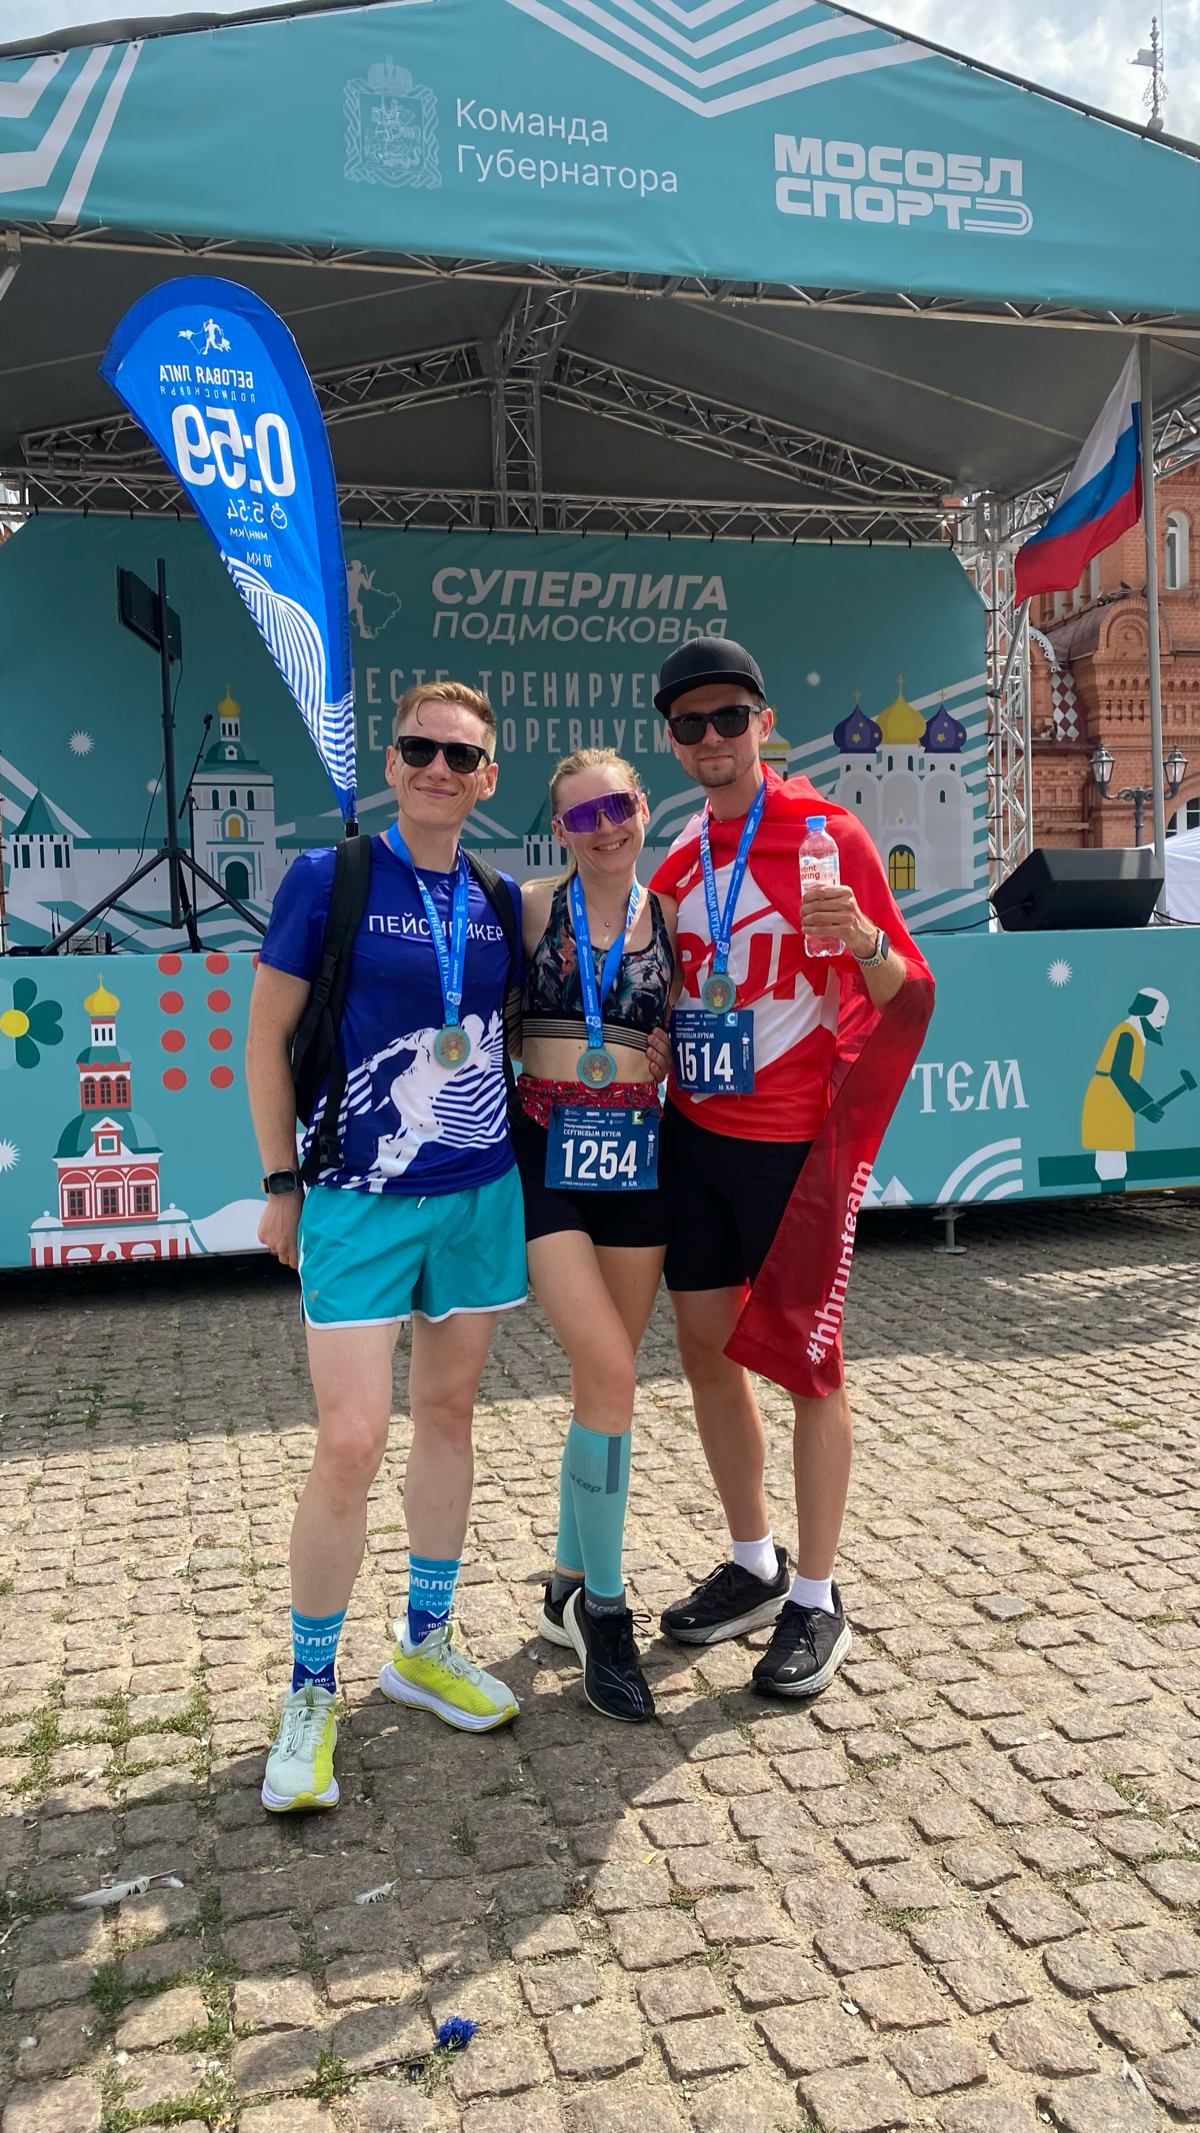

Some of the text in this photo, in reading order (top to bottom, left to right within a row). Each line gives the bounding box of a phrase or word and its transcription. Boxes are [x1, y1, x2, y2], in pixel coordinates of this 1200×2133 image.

[456, 97, 609, 144] Команда
[456, 143, 679, 197] Губернатора
[774, 133, 1024, 197] МОСОБЛ
[775, 178, 1033, 236] СПОРТ
[431, 566, 729, 612] СУПЕРЛИГА
[432, 610, 728, 647] ПОДМОСКОВЬЯ
[502, 717, 671, 754] ОРЕВНУЕМ
[800, 872, 820, 882] pring
[368, 912, 503, 941] ПЕЙСЙКЕР
[677, 1042, 734, 1082] 1514
[911, 1059, 1029, 1114] ТЕМ
[561, 1138, 638, 1180] 1254
[806, 1160, 875, 1367] #hhrunteam
